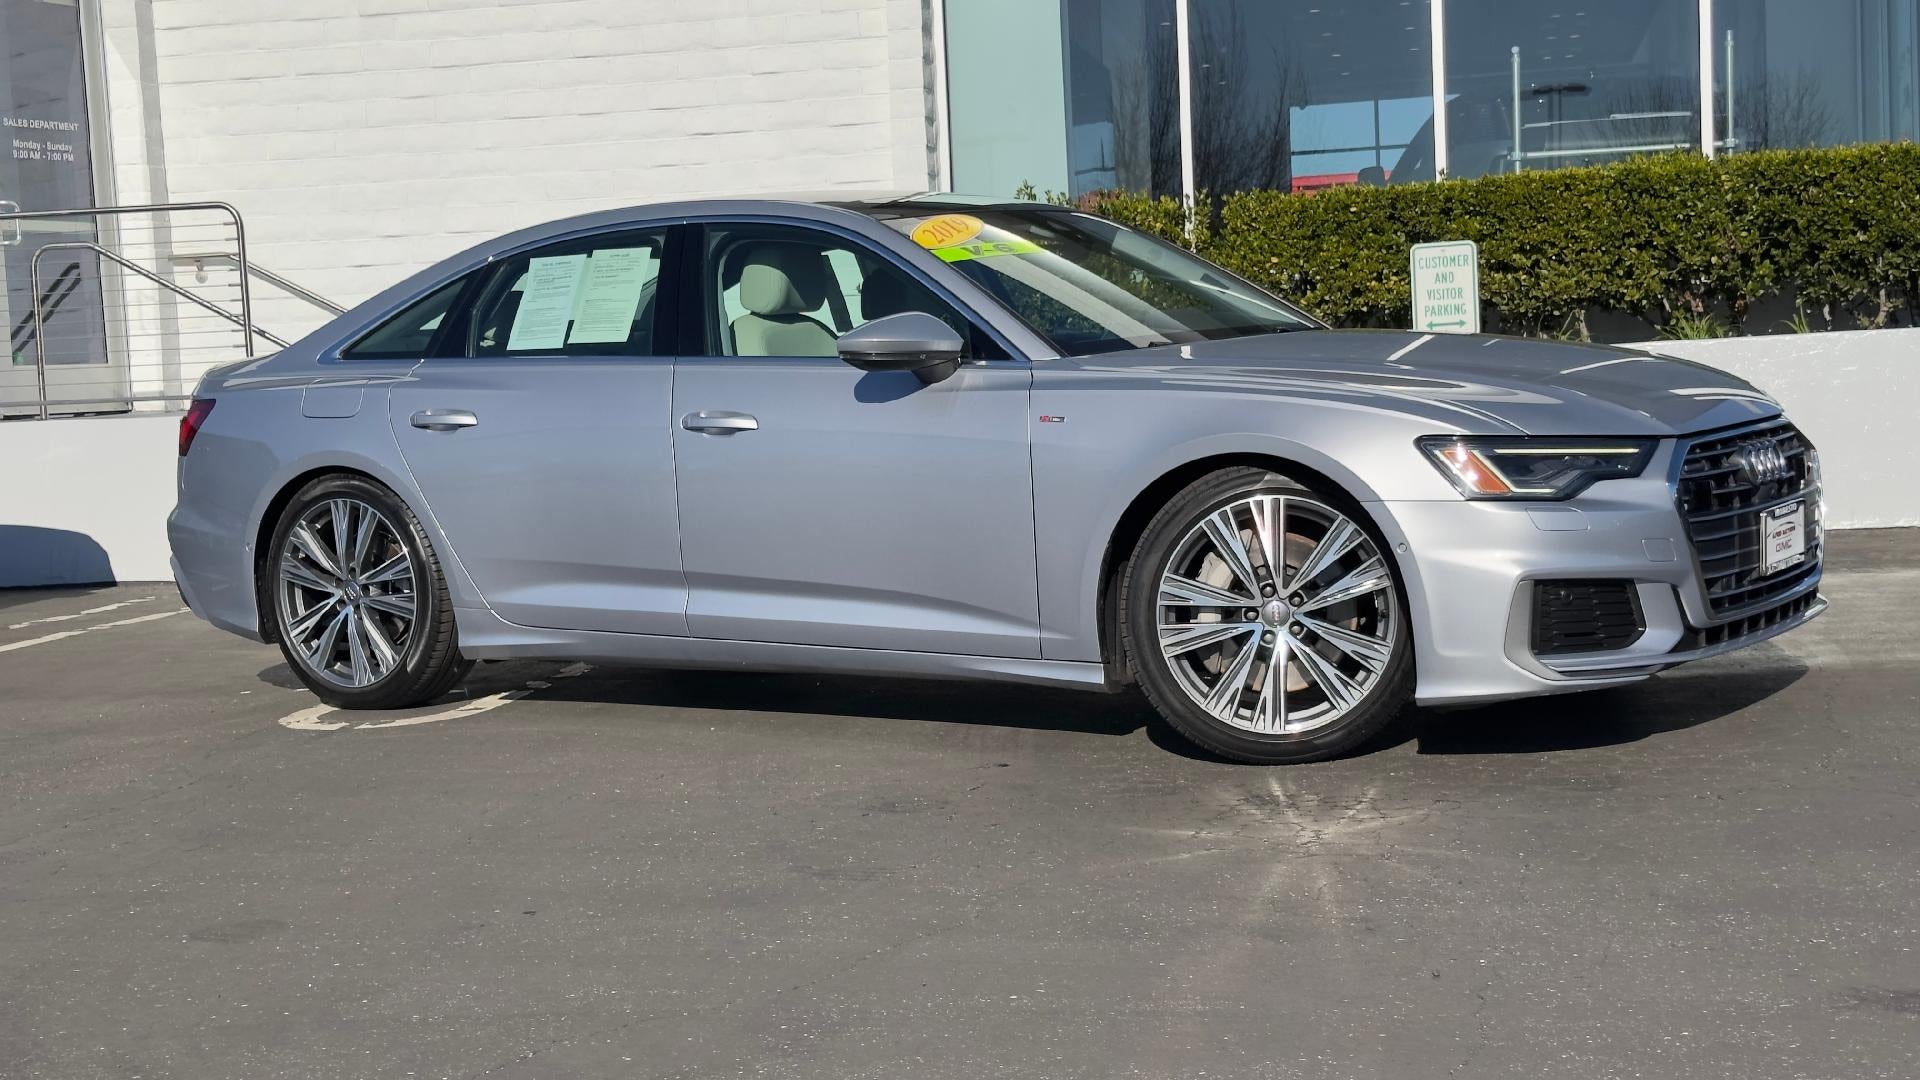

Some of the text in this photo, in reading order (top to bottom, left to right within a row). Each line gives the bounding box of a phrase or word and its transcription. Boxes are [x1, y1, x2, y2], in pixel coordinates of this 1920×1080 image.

[3, 117, 79, 131] SALES DEPARTMENT
[12, 139, 40, 151] Monday
[46, 141, 72, 153] Sunday
[12, 149, 29, 159] 9:00
[29, 150, 41, 160] AM
[46, 152, 61, 161] 7:00
[62, 153, 74, 162] PM
[923, 218, 969, 244] 2019
[1419, 255, 1469, 269] CUSTOMER
[1434, 271, 1455, 285] AND
[1426, 287, 1464, 301] VISITOR
[1424, 303, 1467, 318] PARKING
